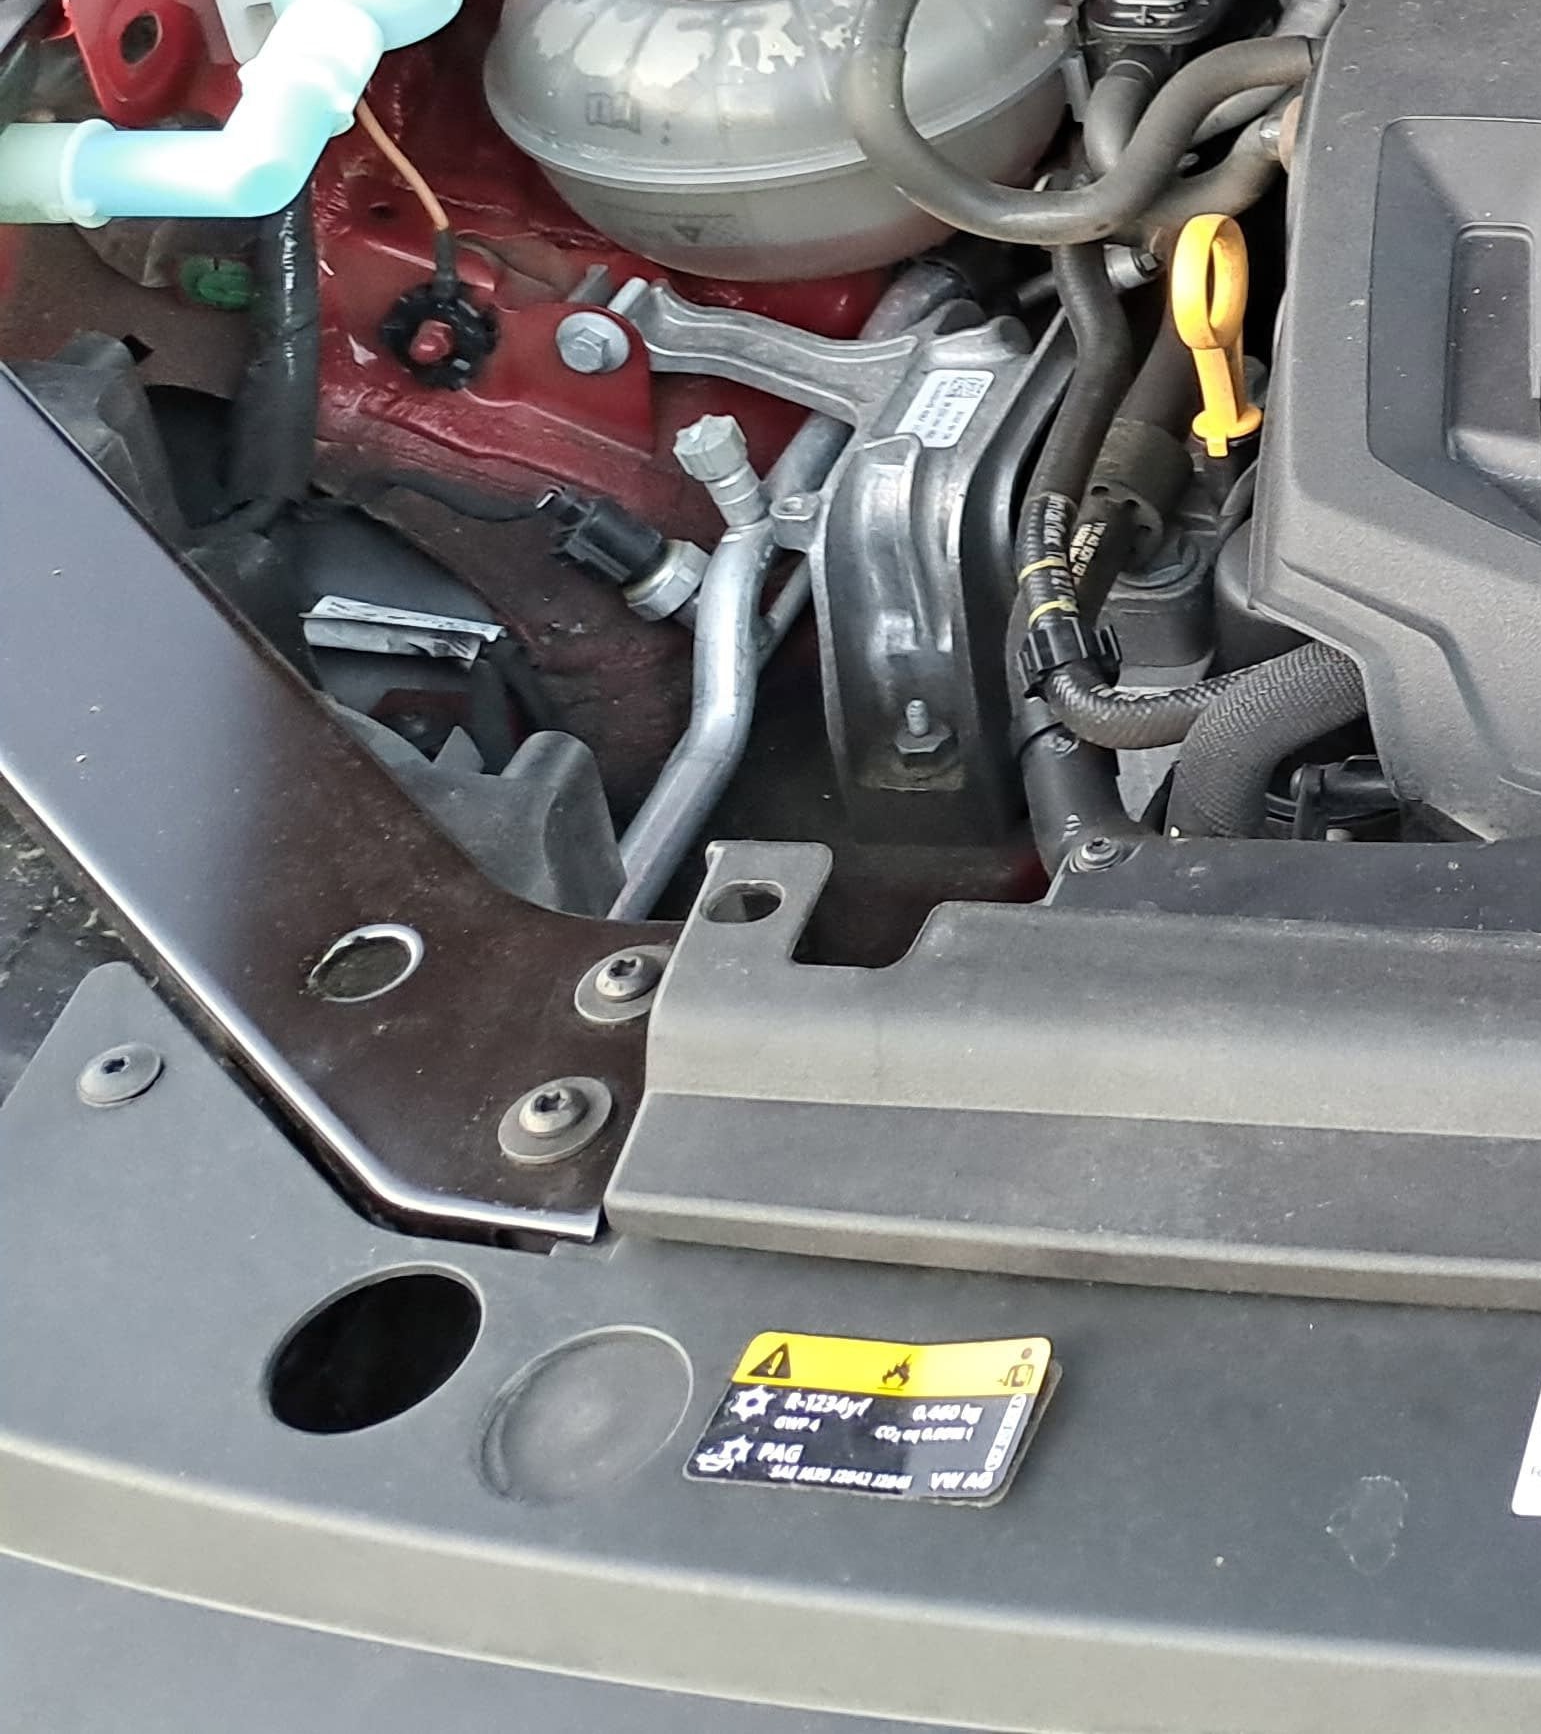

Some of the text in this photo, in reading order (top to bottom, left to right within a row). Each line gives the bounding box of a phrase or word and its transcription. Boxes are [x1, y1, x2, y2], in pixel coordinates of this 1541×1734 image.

[757, 1441, 804, 1463] PAG
[929, 1471, 995, 1491] VW AG
